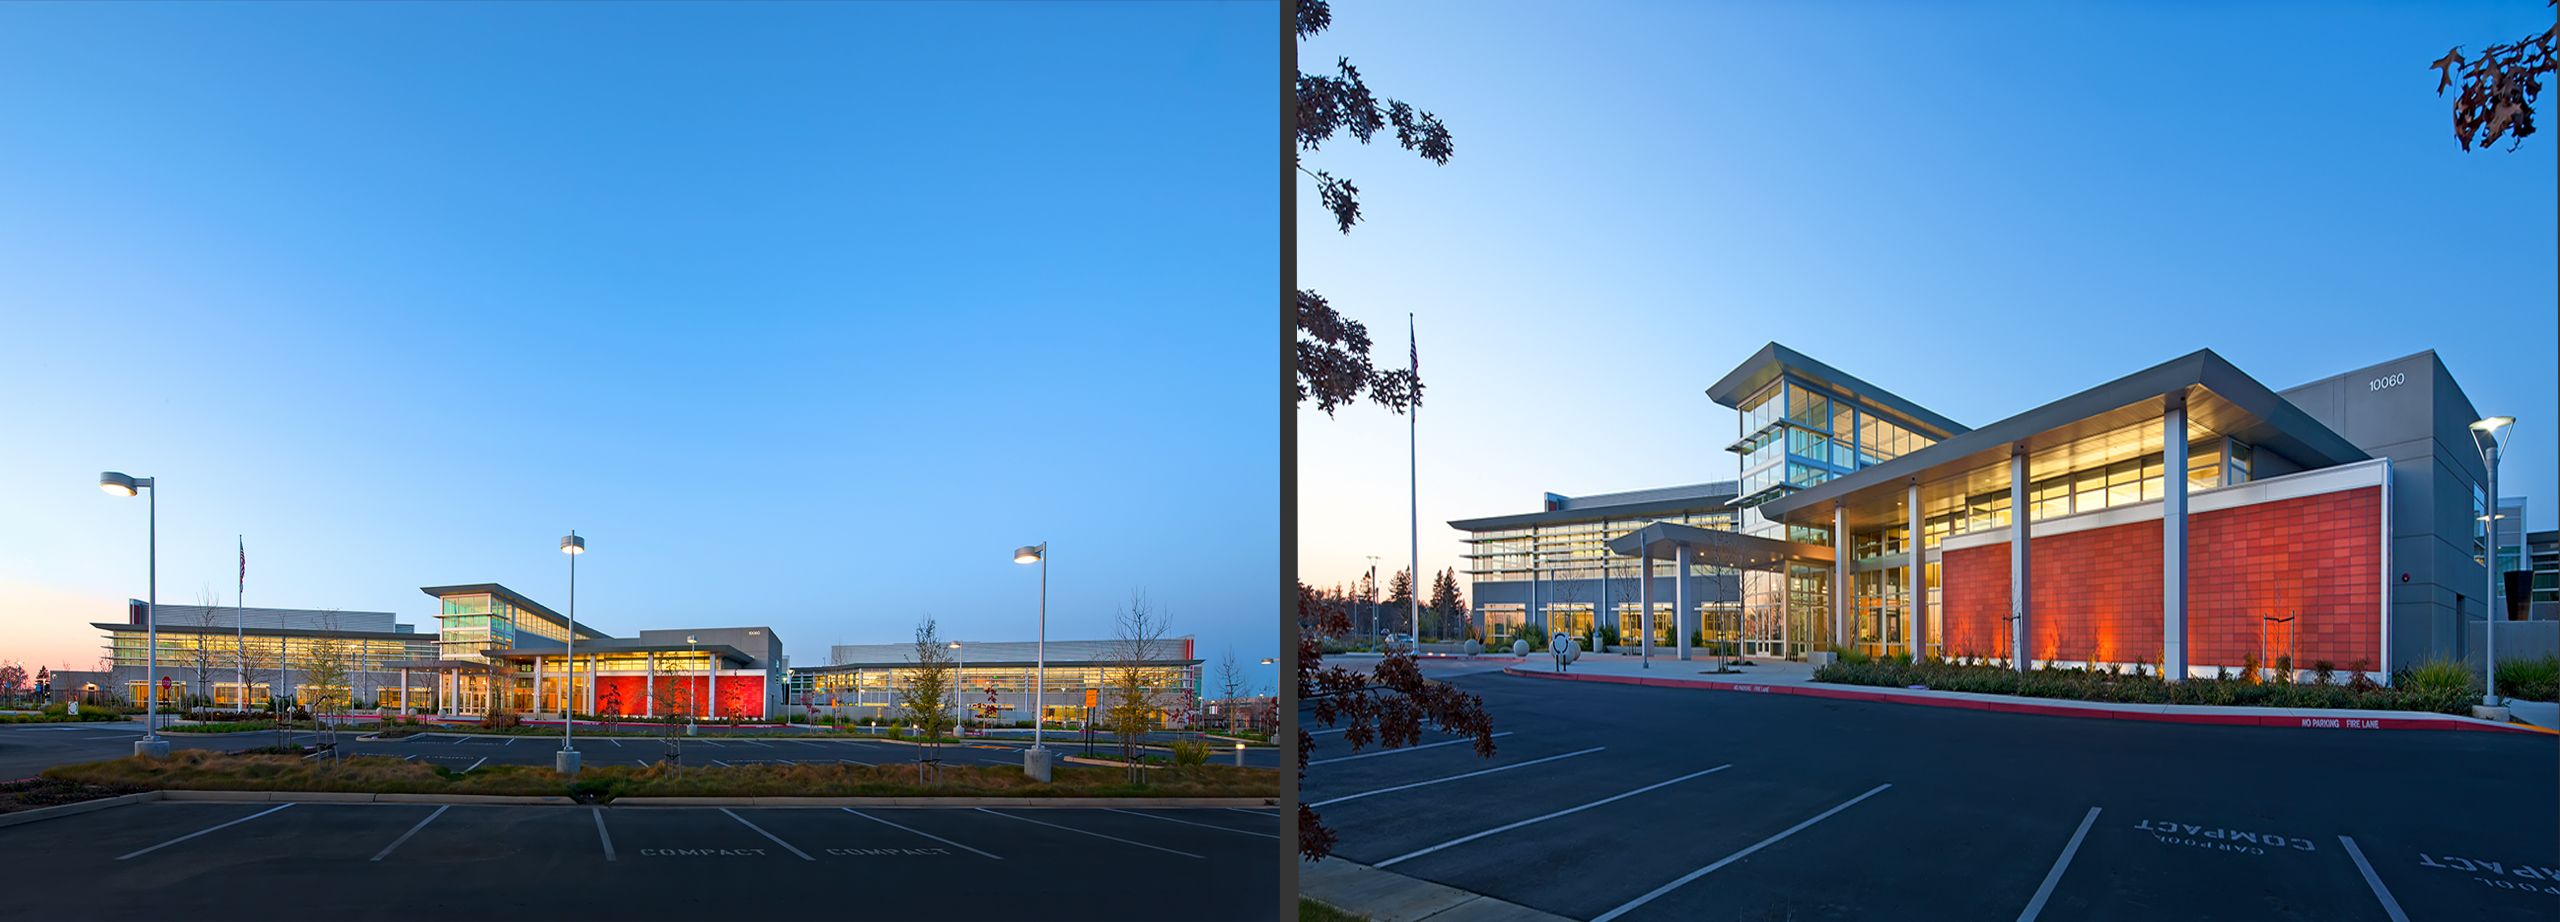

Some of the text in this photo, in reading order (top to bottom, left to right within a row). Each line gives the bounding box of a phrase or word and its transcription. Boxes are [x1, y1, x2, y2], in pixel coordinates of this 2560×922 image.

[2369, 372, 2405, 391] 10060
[2302, 718, 2379, 729] NO PARKING FIRE LANE
[2134, 819, 2316, 851] COMPACT
[2152, 831, 2265, 855] CARPOOL
[640, 847, 767, 857] COMPACT
[825, 847, 953, 857] COMPACT
